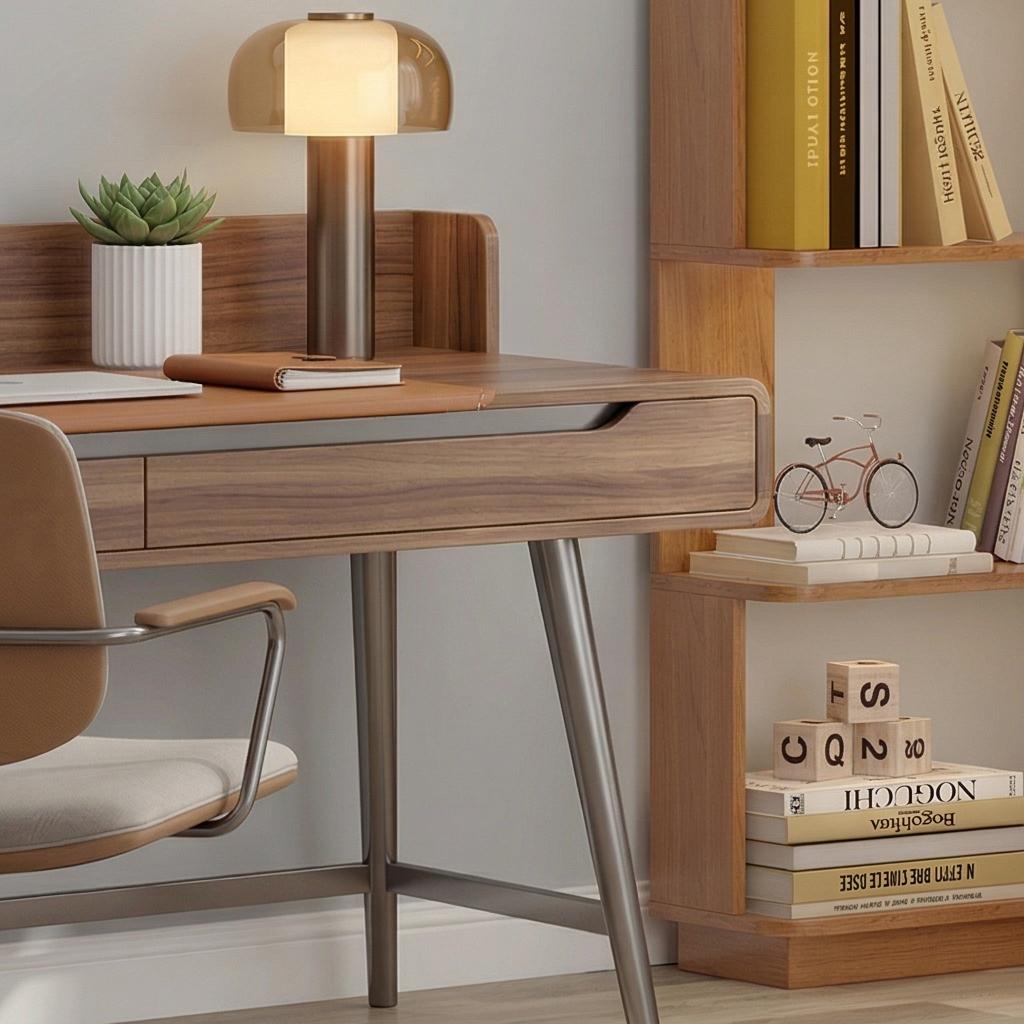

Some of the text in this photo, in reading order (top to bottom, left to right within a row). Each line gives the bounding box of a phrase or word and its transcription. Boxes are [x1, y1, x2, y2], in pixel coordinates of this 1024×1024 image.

[860, 682, 890, 708] S
[781, 736, 807, 764] C
[825, 733, 845, 767] Q
[861, 737, 888, 760] 2
[844, 779, 977, 811] NOGUCHI
